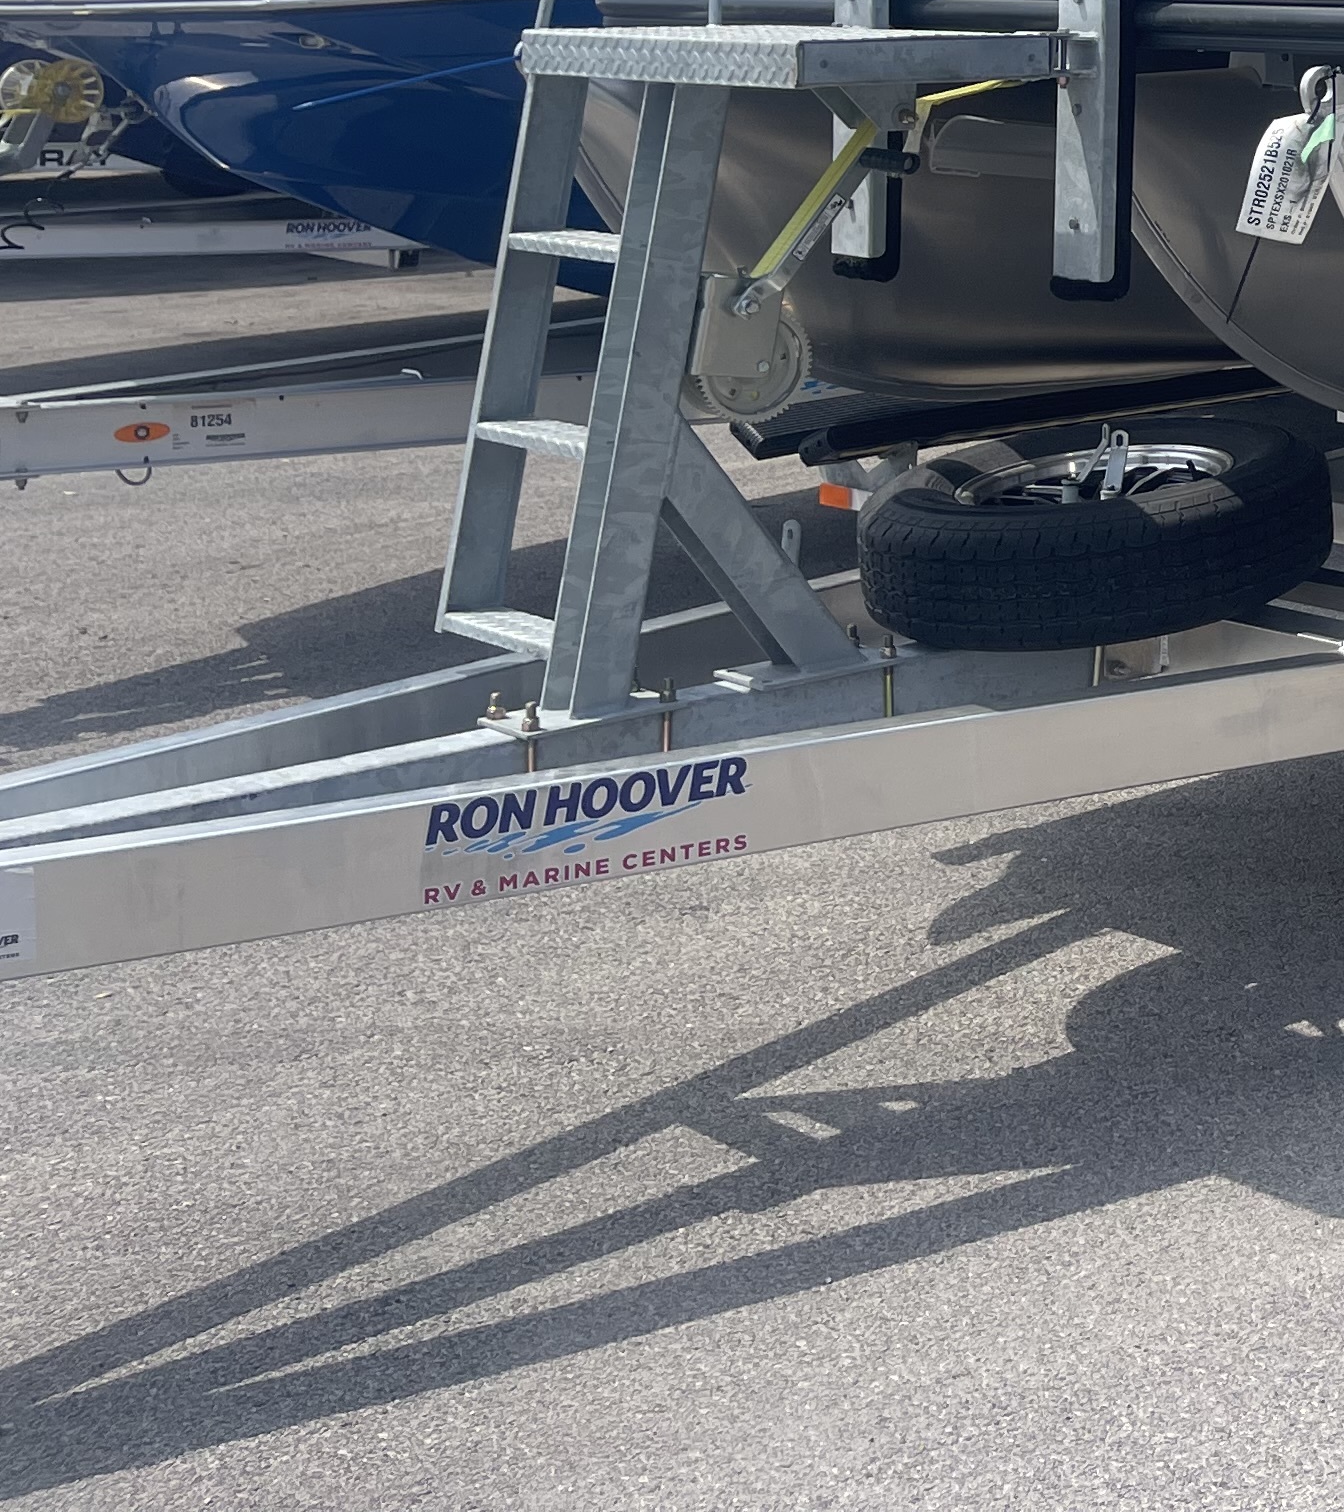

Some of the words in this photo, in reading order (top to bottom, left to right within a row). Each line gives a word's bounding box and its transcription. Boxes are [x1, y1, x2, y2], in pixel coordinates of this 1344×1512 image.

[286, 222, 315, 234] RON
[317, 219, 371, 233] HOOVER
[190, 413, 232, 428] 81254
[425, 789, 537, 846] RON
[543, 756, 747, 826] HOOVER
[423, 883, 462, 905] RV
[470, 880, 487, 896] &
[499, 858, 610, 892] MARINE
[622, 834, 747, 870] CENTERS
